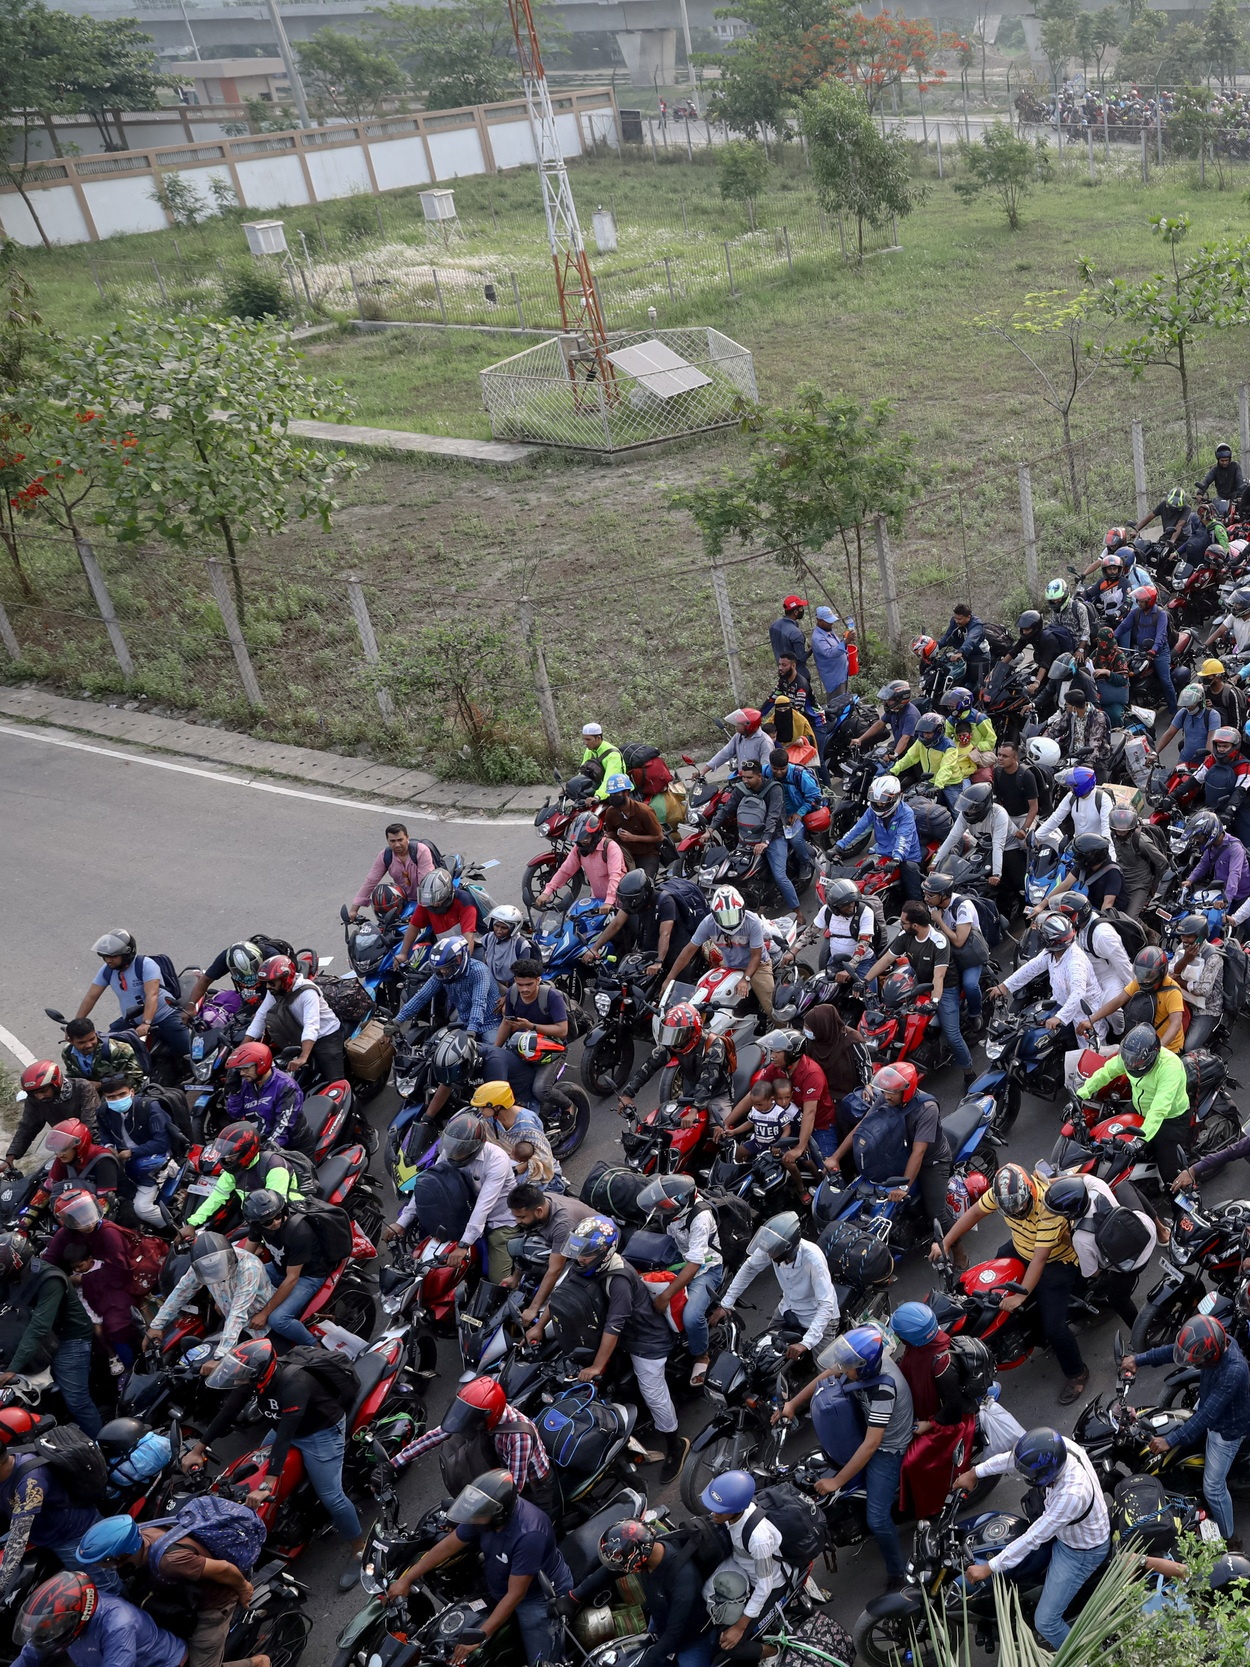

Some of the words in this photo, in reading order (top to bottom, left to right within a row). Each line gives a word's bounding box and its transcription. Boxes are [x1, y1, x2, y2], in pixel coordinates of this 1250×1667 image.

[1038, 848, 1051, 857] 46
[1149, 1454, 1162, 1464] TVS
[81, 1588, 95, 1621] STUDDS
